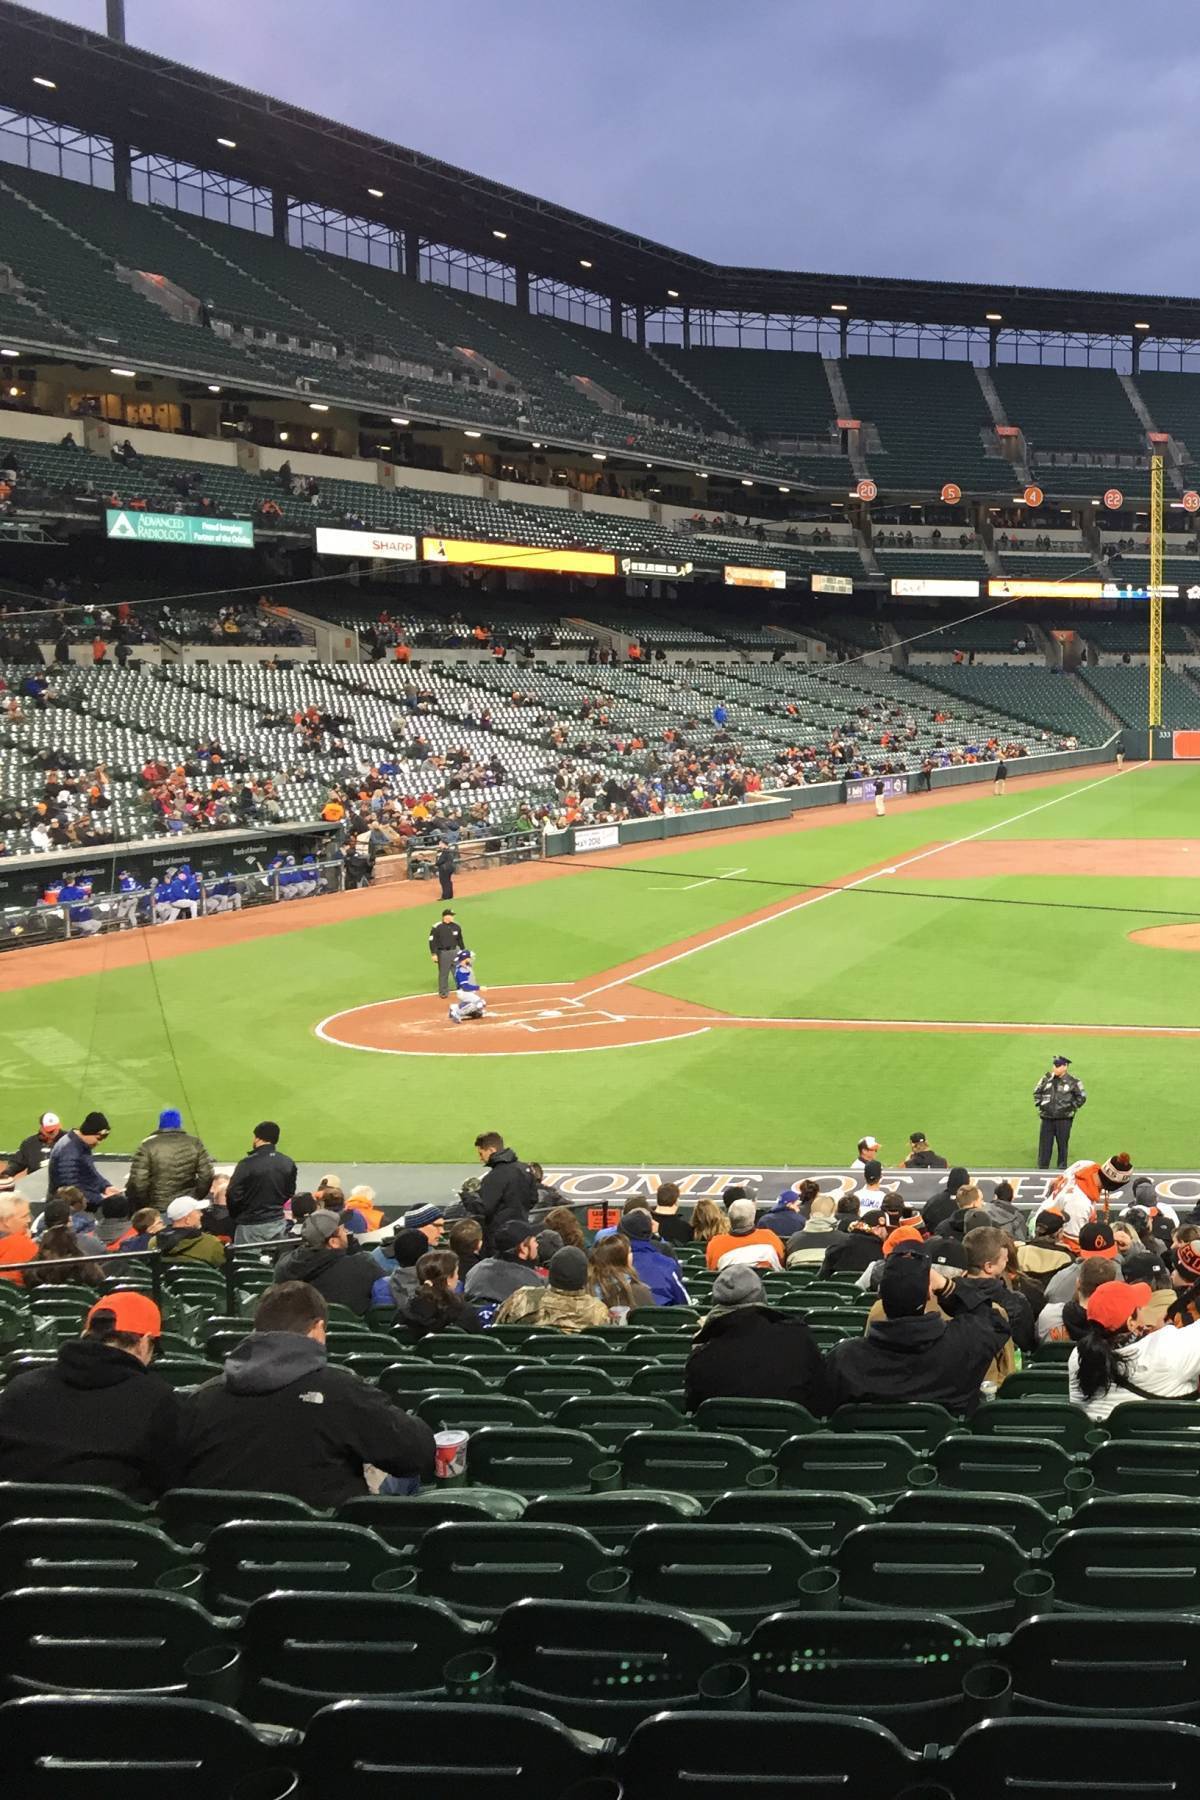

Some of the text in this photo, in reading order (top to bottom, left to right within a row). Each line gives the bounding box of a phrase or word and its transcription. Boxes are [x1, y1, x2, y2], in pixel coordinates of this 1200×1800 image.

[860, 486, 875, 496] 20
[1106, 495, 1120, 505] 22
[1185, 497, 1198, 507] 33
[372, 540, 413, 552] SHARP
